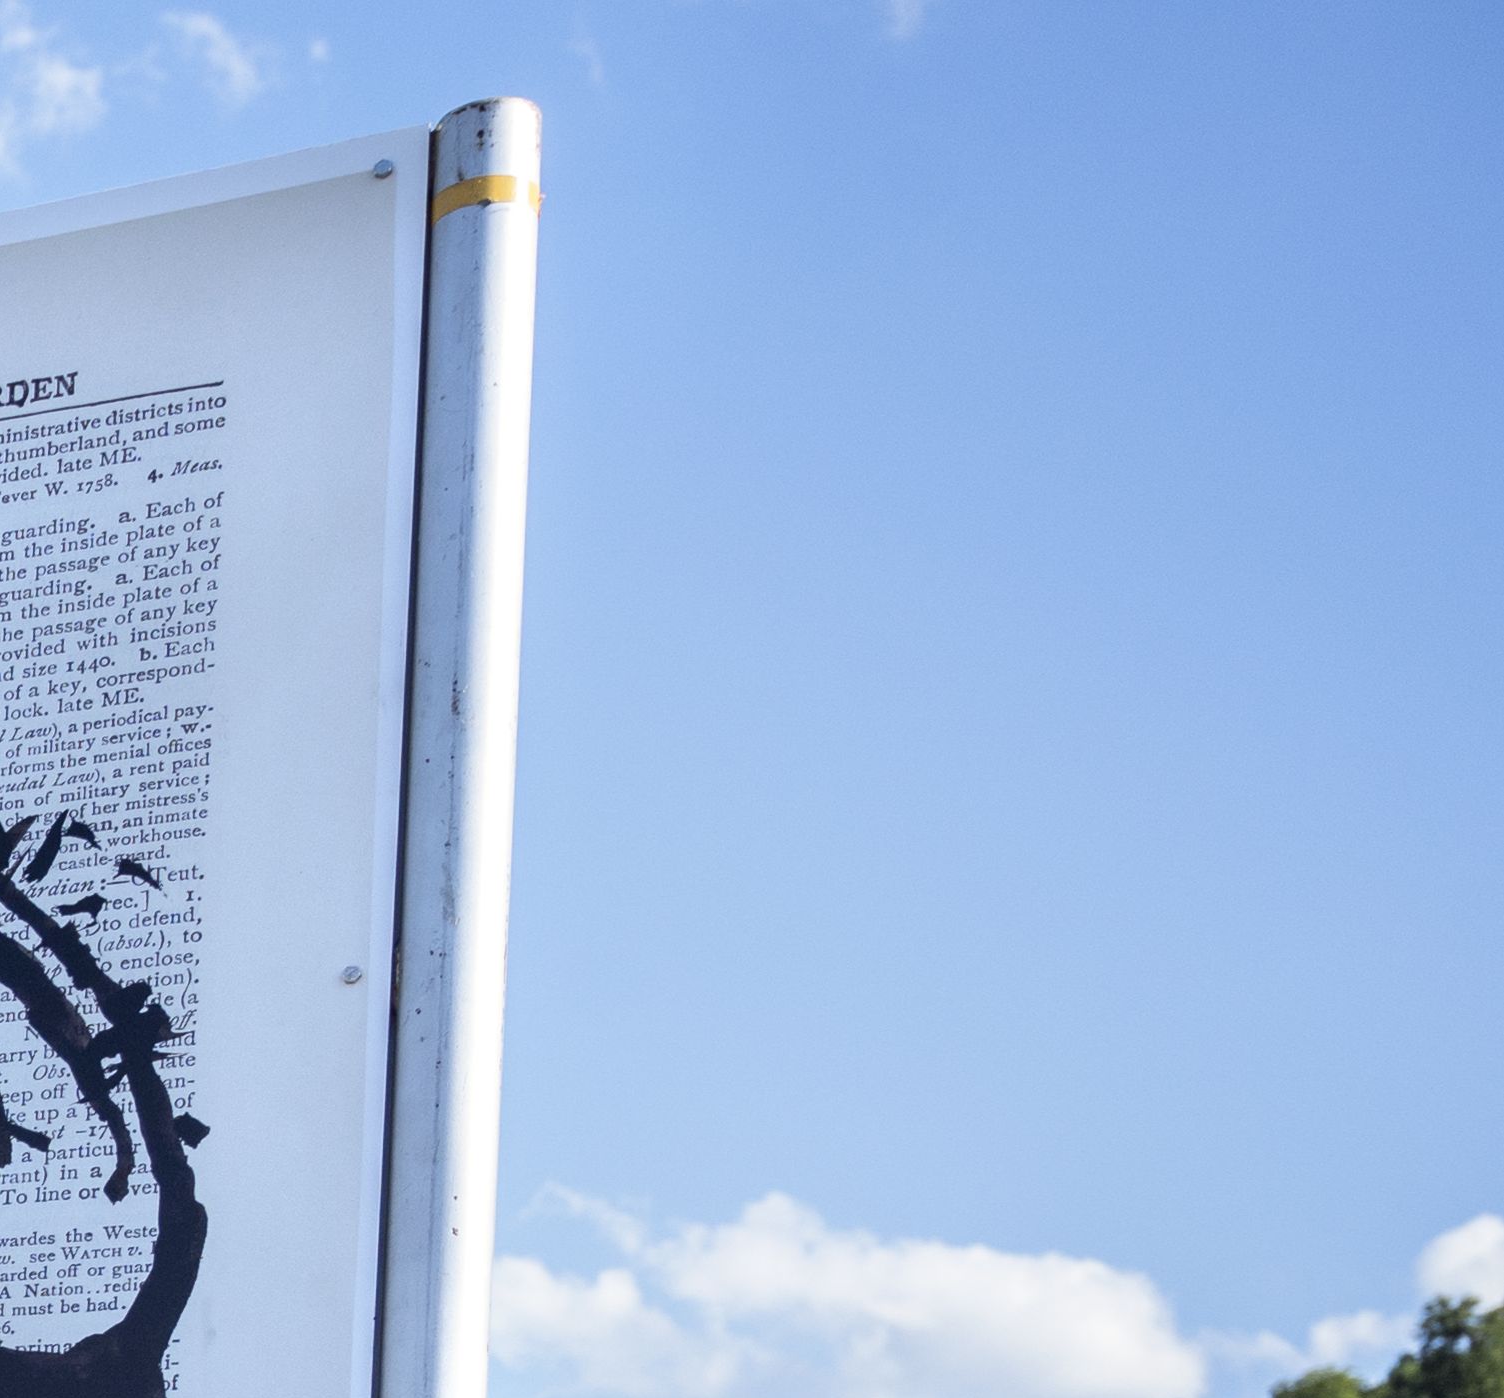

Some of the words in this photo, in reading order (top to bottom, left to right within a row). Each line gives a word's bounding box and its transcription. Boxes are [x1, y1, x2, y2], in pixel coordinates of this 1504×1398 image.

[104, 401, 184, 427] districts
[186, 395, 227, 414] into
[131, 420, 170, 442] and
[172, 415, 227, 436] some
[55, 456, 93, 475] late
[97, 445, 142, 468] ME.
[114, 572, 134, 586] a.
[141, 557, 193, 582] Each
[199, 552, 222, 572] of
